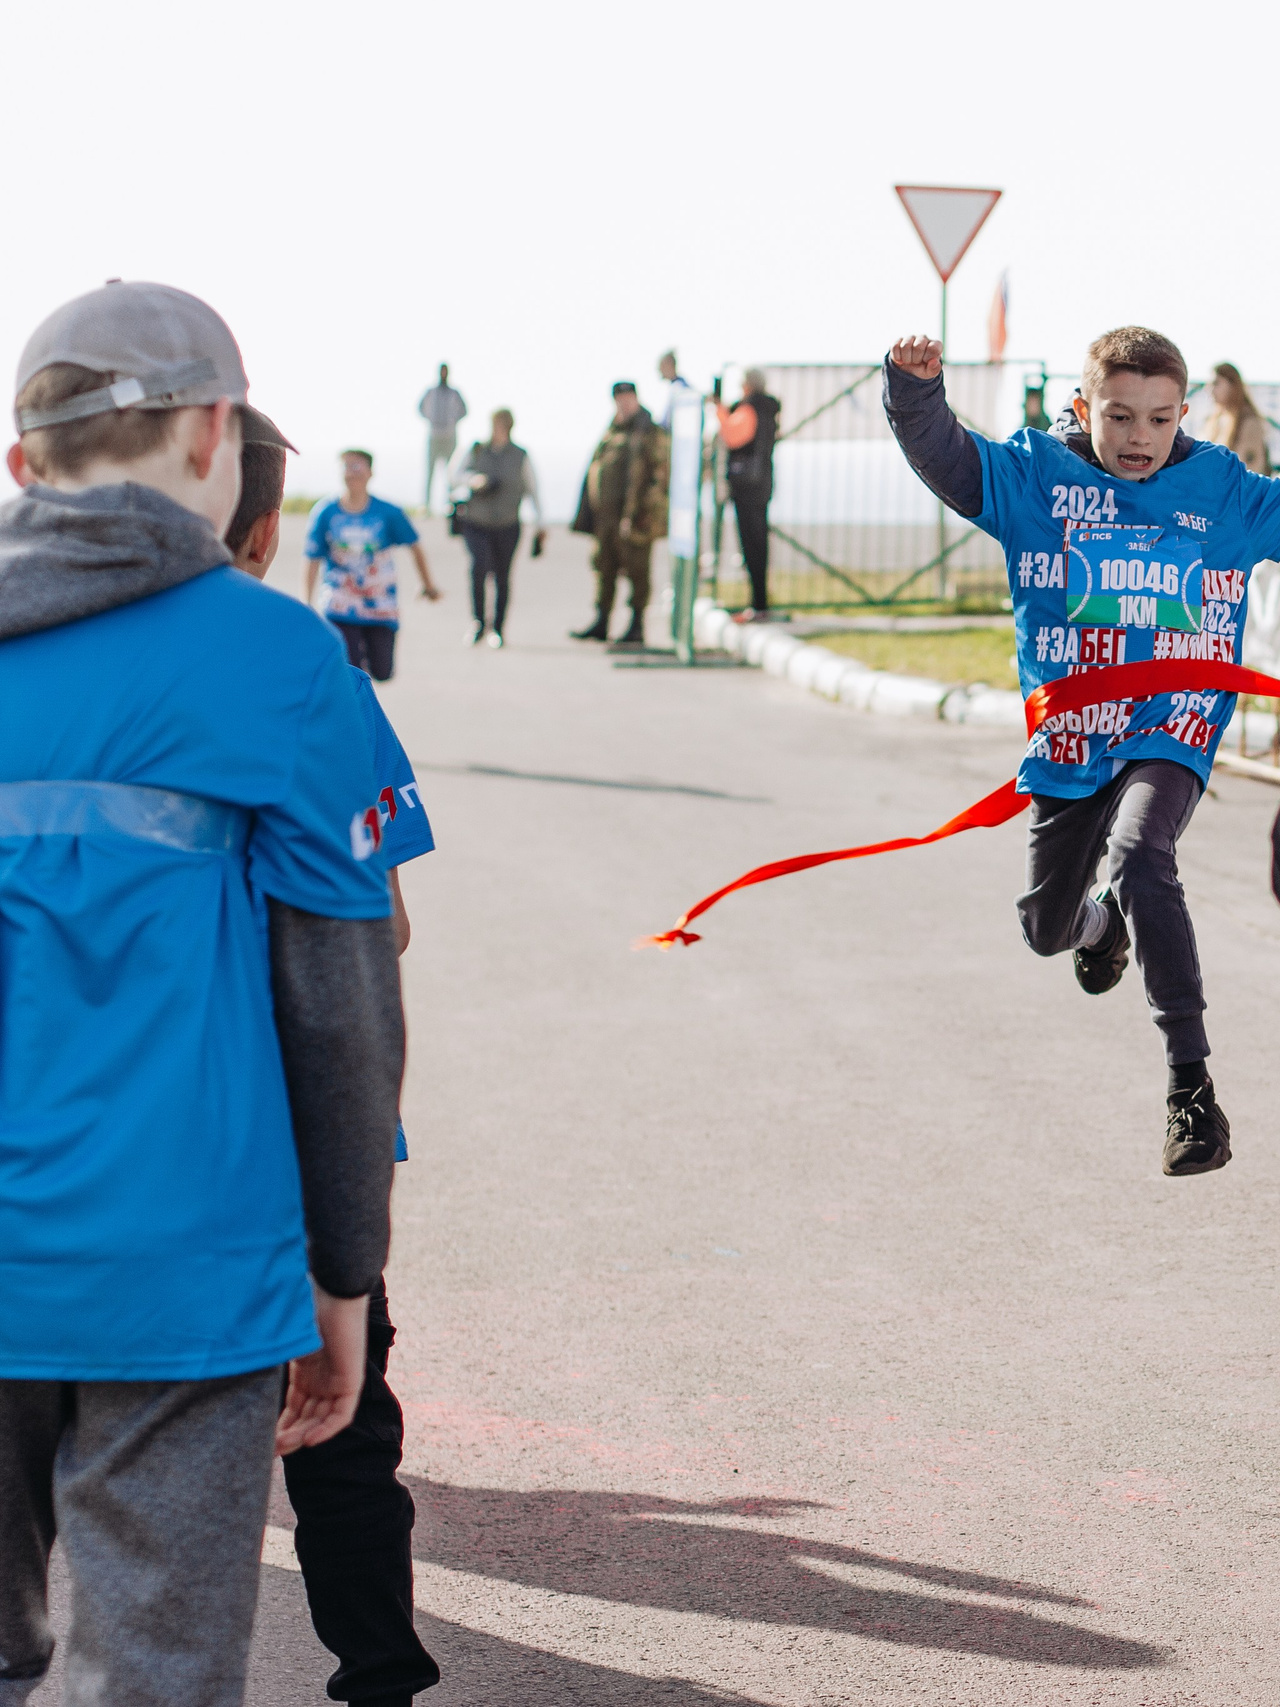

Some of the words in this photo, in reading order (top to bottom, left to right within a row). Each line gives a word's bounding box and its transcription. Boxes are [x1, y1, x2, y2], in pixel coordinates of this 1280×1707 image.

[1051, 484, 1119, 522] 2024
[1099, 558, 1179, 596] 10046
[1036, 626, 1127, 666] #ЗАБЕГ
